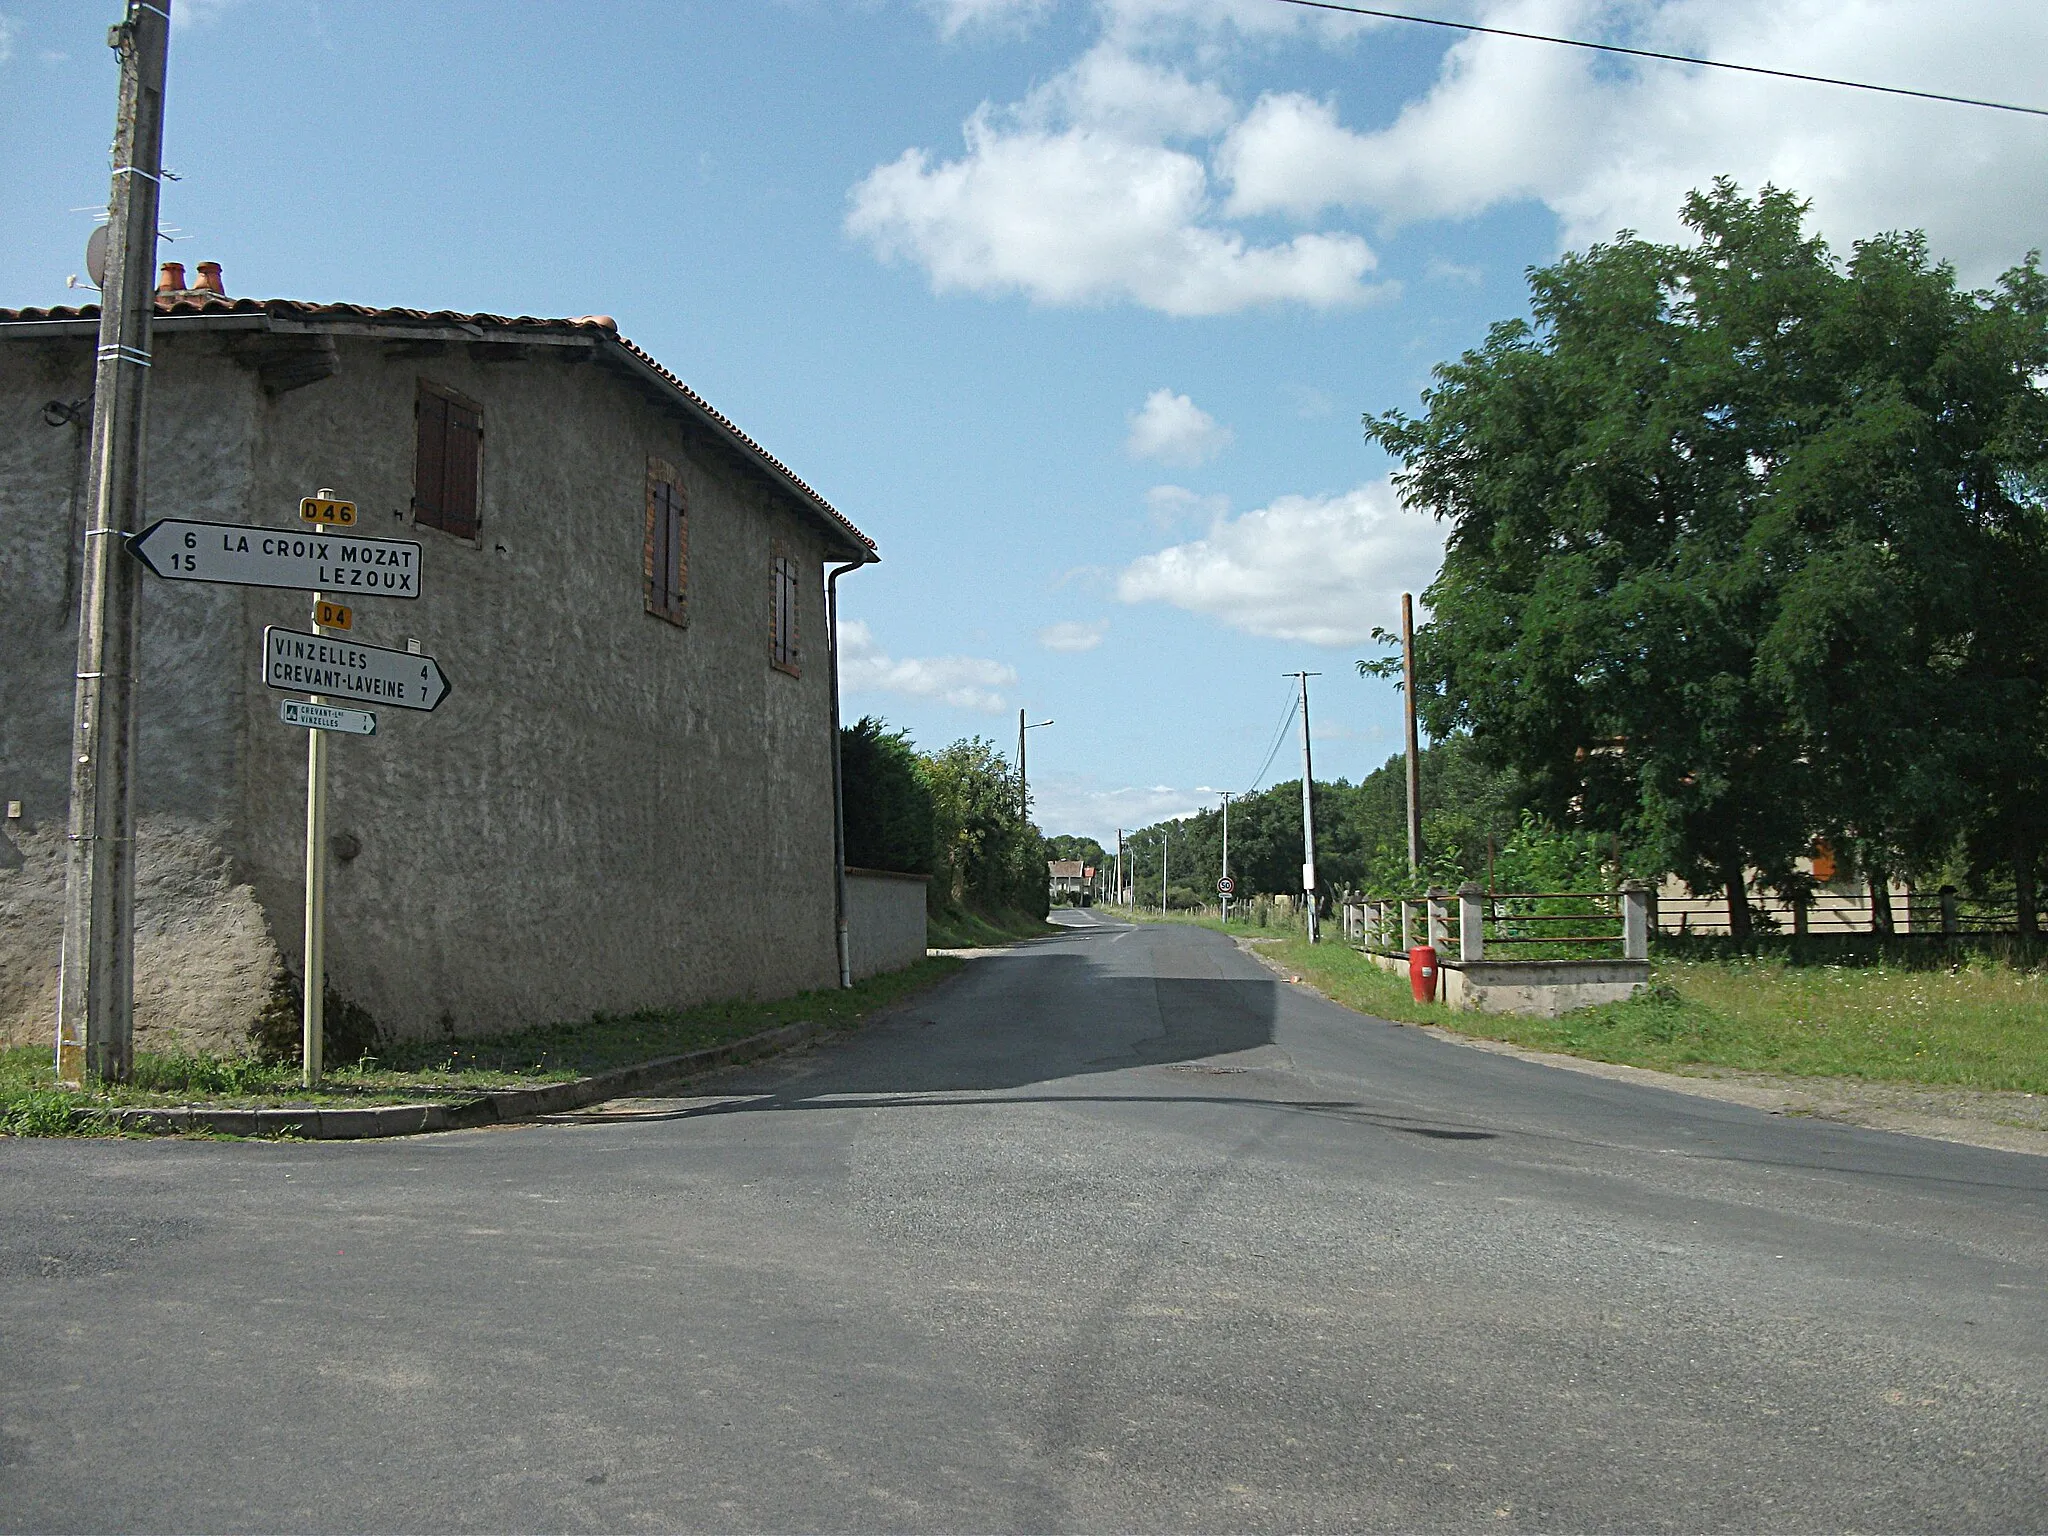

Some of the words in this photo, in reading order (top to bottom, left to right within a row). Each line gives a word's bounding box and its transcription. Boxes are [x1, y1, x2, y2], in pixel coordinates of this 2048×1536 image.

[305, 503, 353, 523] D46
[185, 532, 196, 548] 6
[223, 534, 249, 552] LA
[262, 539, 329, 560] CROIX
[341, 545, 412, 568] MOZAT
[171, 554, 196, 572] 15
[320, 566, 411, 590] LEZOUX
[324, 606, 345, 625] D4
[275, 638, 367, 669] VINZELLES
[420, 666, 428, 680] 4
[274, 663, 404, 698] CREVANT-LAVEINE
[421, 687, 428, 701] 7
[301, 716, 338, 727] VINZELLES
